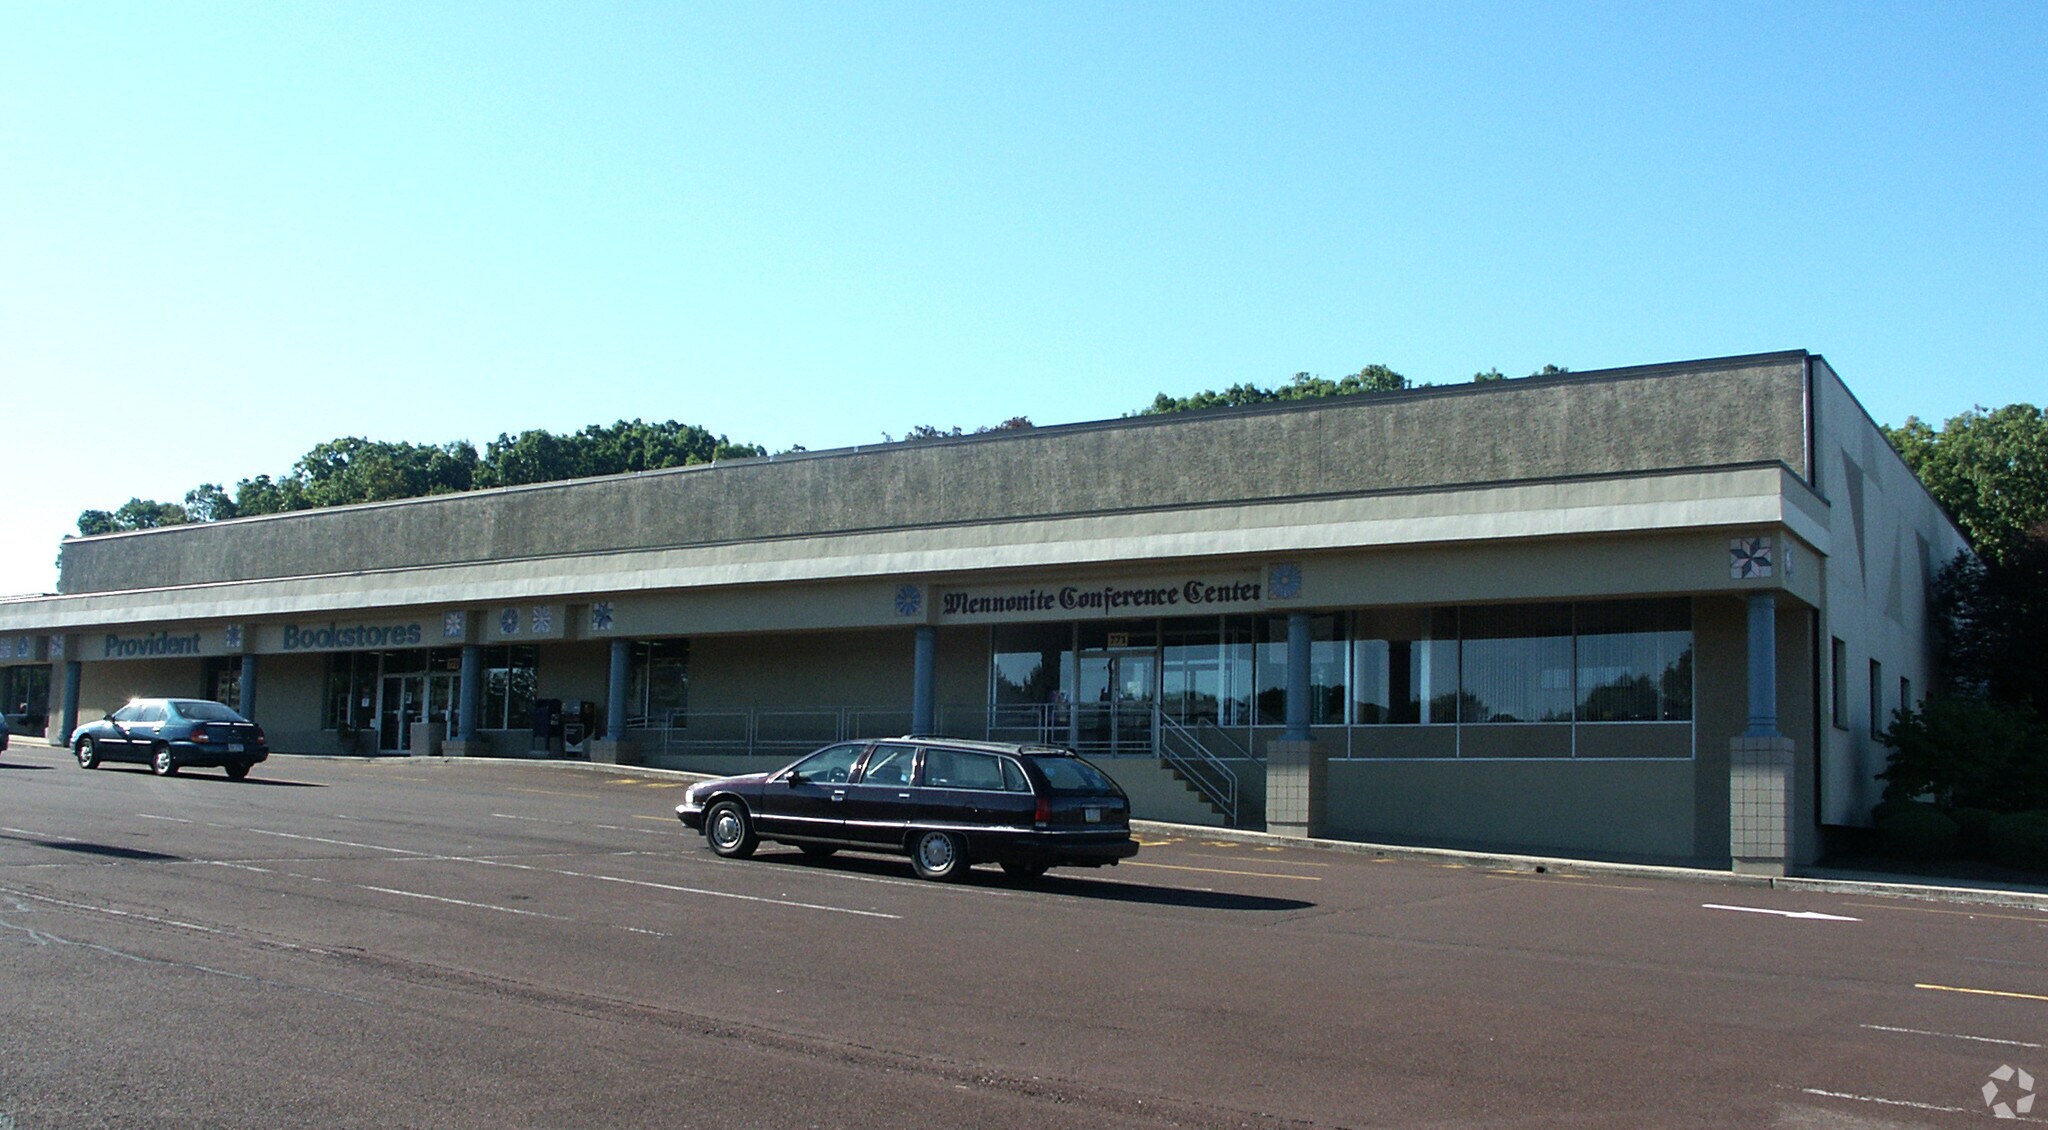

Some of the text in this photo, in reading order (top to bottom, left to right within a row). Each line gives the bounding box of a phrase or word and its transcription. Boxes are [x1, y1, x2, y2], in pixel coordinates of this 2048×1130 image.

[943, 580, 1260, 615] Mennonite Conference Center
[105, 622, 422, 657] Provident Bookstores
